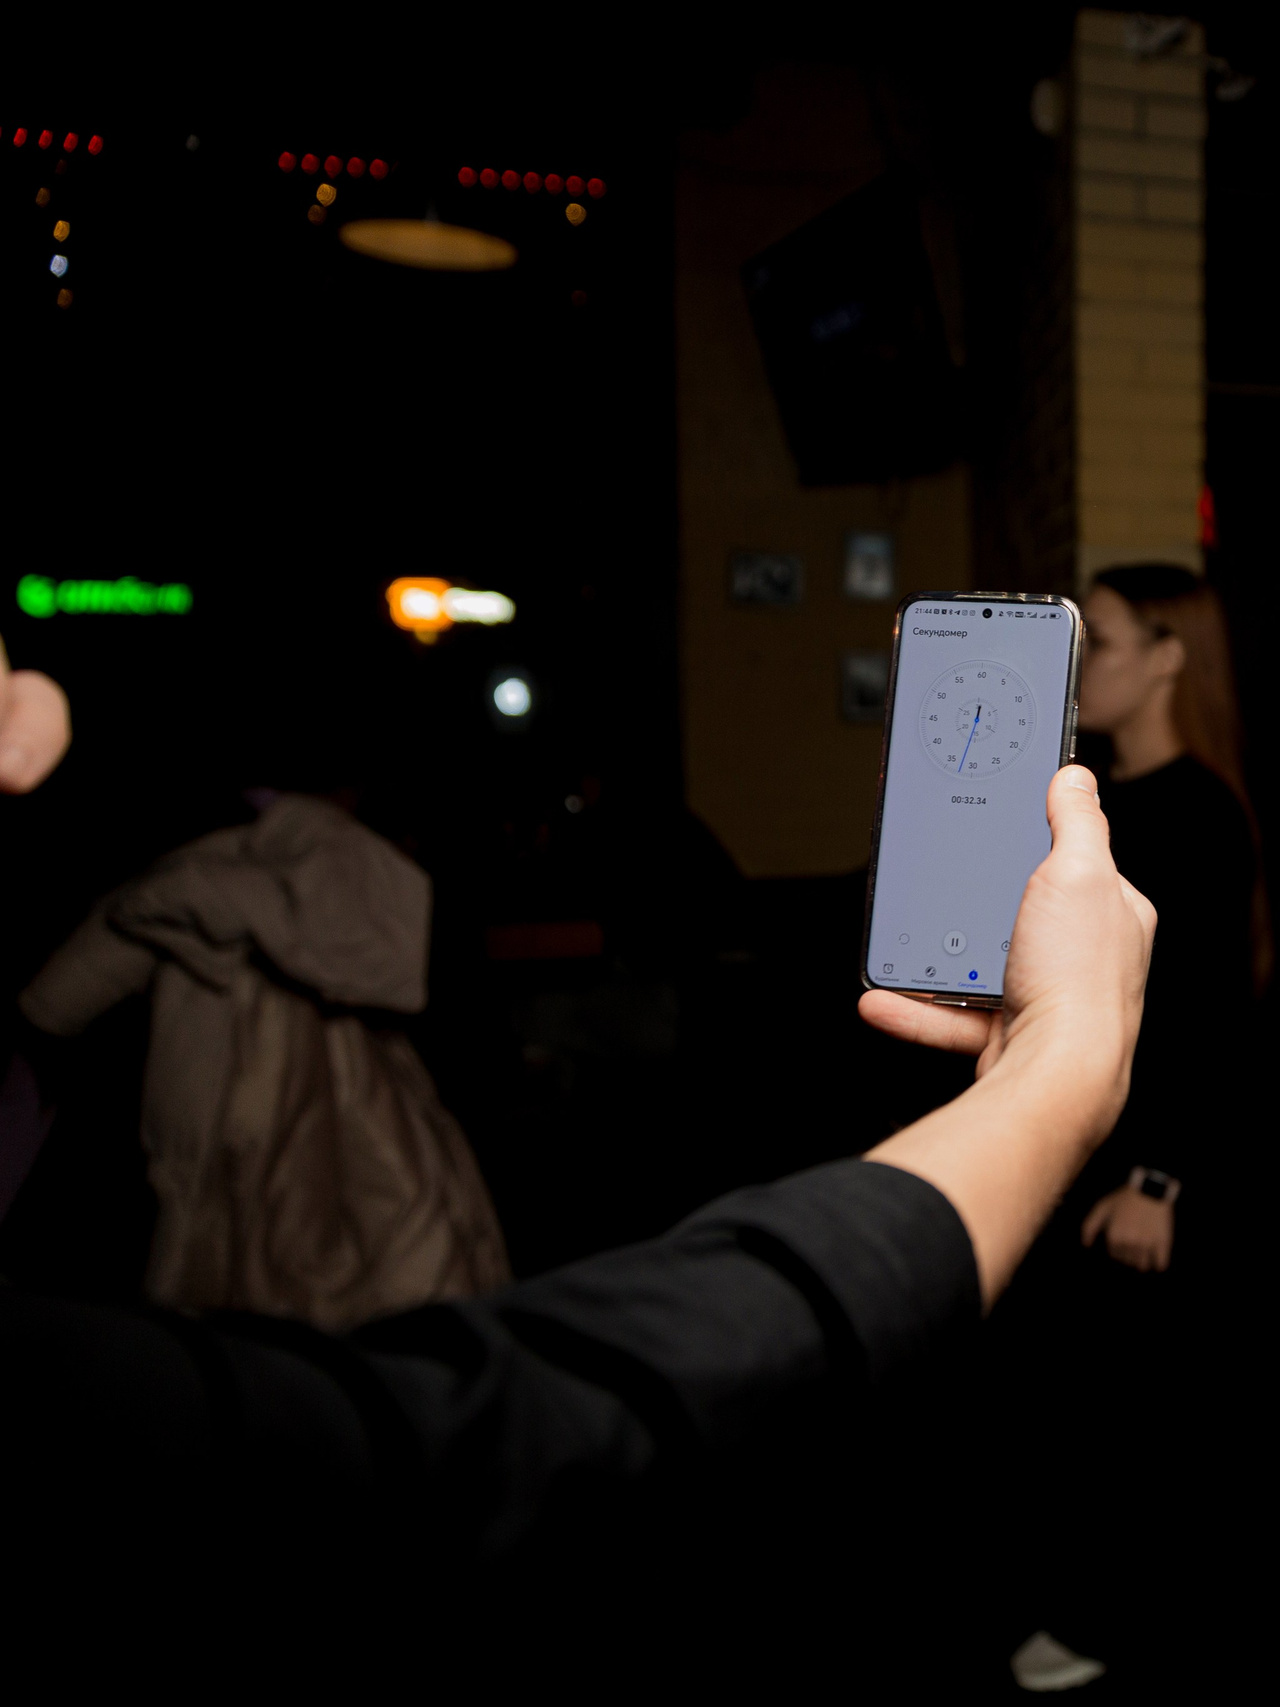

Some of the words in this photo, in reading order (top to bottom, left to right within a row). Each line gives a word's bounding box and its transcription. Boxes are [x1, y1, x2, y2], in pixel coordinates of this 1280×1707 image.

[913, 627, 968, 639] Секундомер
[977, 671, 987, 679] 60
[955, 676, 964, 684] 55
[951, 796, 987, 805] 00:32.34
